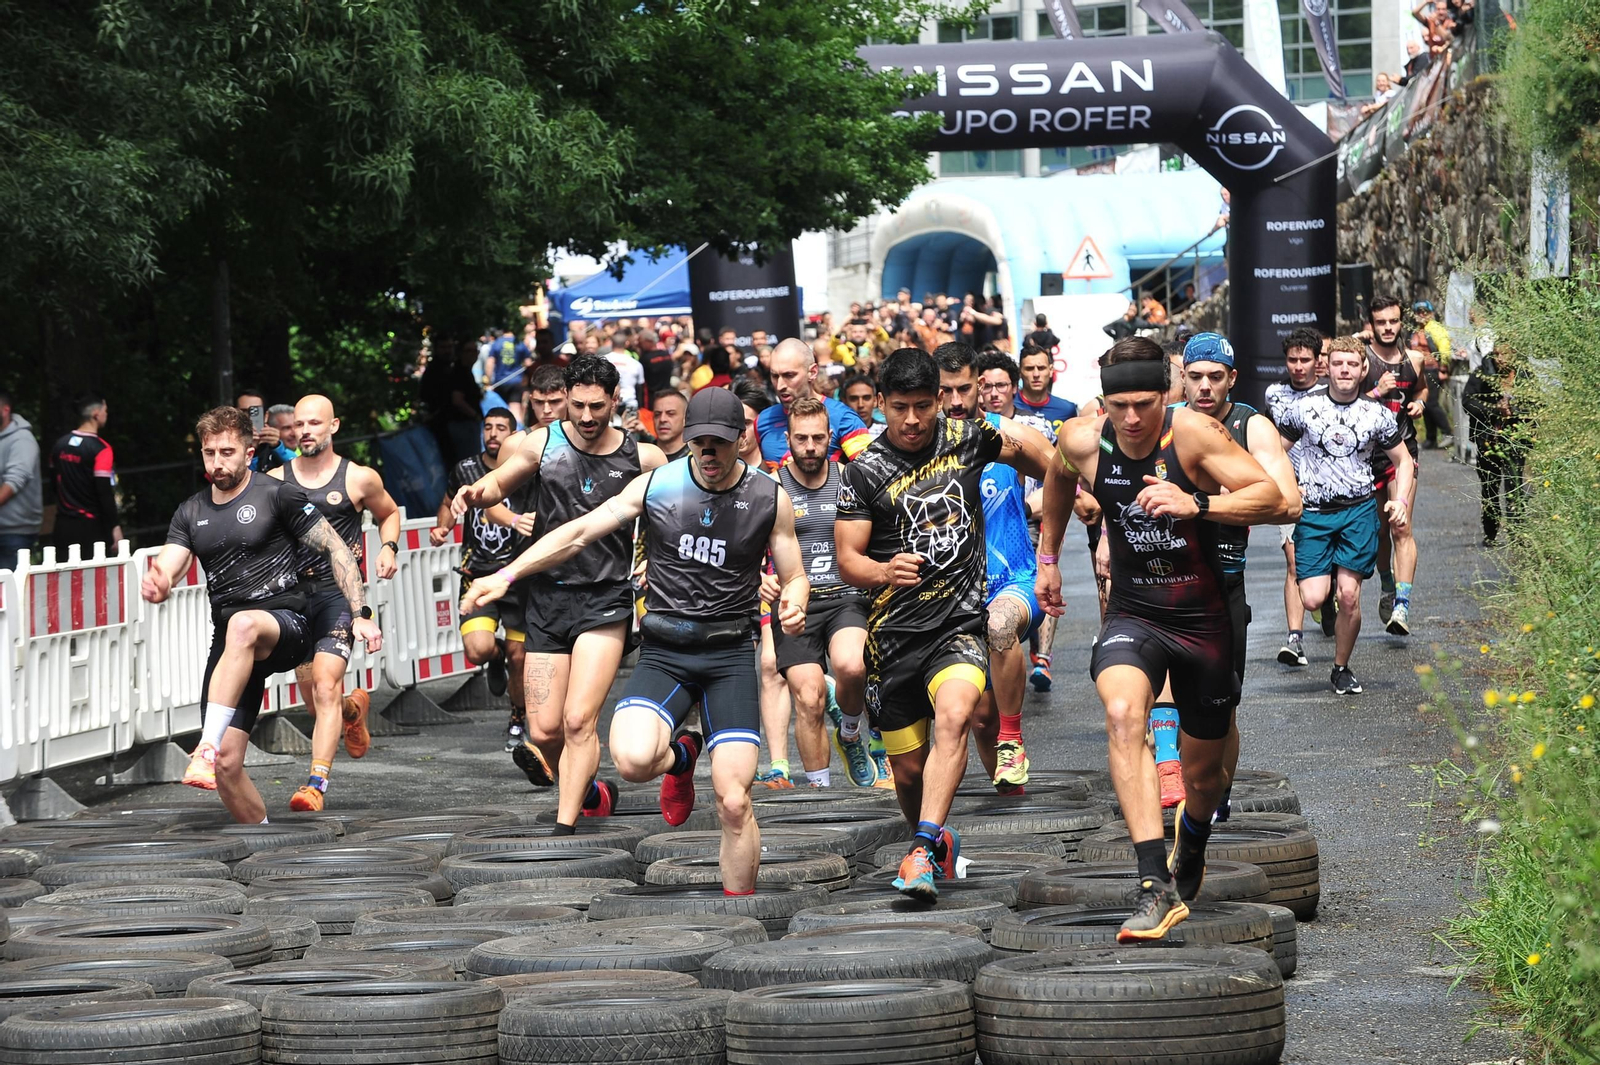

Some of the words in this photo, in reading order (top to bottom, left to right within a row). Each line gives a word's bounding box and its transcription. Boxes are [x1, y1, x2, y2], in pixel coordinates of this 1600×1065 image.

[881, 59, 1154, 97] ISSAN
[892, 108, 1018, 135] UPO
[1029, 105, 1152, 133] ROFER
[1206, 130, 1287, 145] NISSAN
[1266, 219, 1325, 231] ROFERVIGO
[1288, 237, 1304, 245] Vigo
[1254, 264, 1331, 279] ROFEROURENSE
[709, 286, 790, 301] ROFEROURENSE
[1280, 284, 1308, 292] Ourense
[1271, 312, 1317, 324] ROIPESA
[1104, 478, 1131, 486] MARCOS
[678, 533, 726, 567] 885
[1133, 543, 1154, 553] PRO
